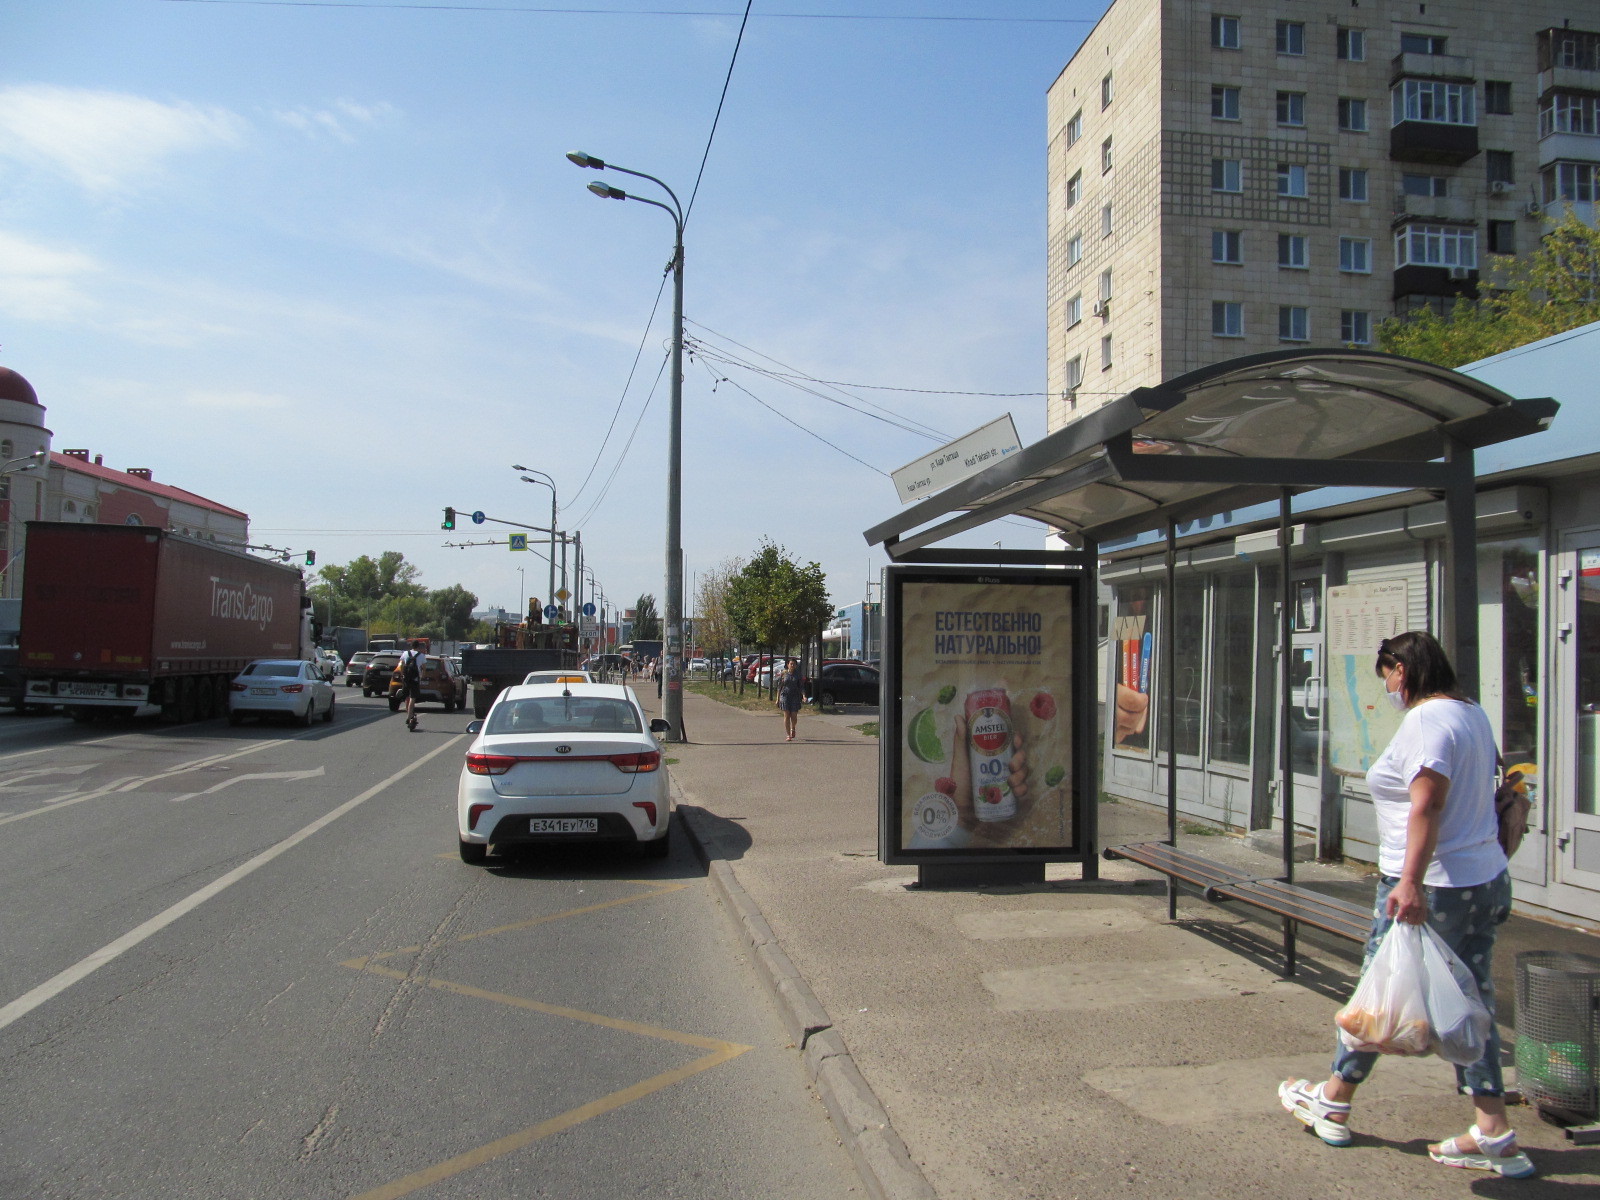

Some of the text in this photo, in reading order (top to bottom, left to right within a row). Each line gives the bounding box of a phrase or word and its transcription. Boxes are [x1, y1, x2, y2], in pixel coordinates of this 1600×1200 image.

[210, 576, 273, 631] TransCargo
[935, 611, 1042, 633] ЕСТЕСТВЕННО
[935, 634, 1042, 655] НАТУРАЛЬНО!
[70, 688, 106, 696] SCHMITZ
[975, 723, 1005, 734] AMSTEL
[578, 819, 595, 828] 716
